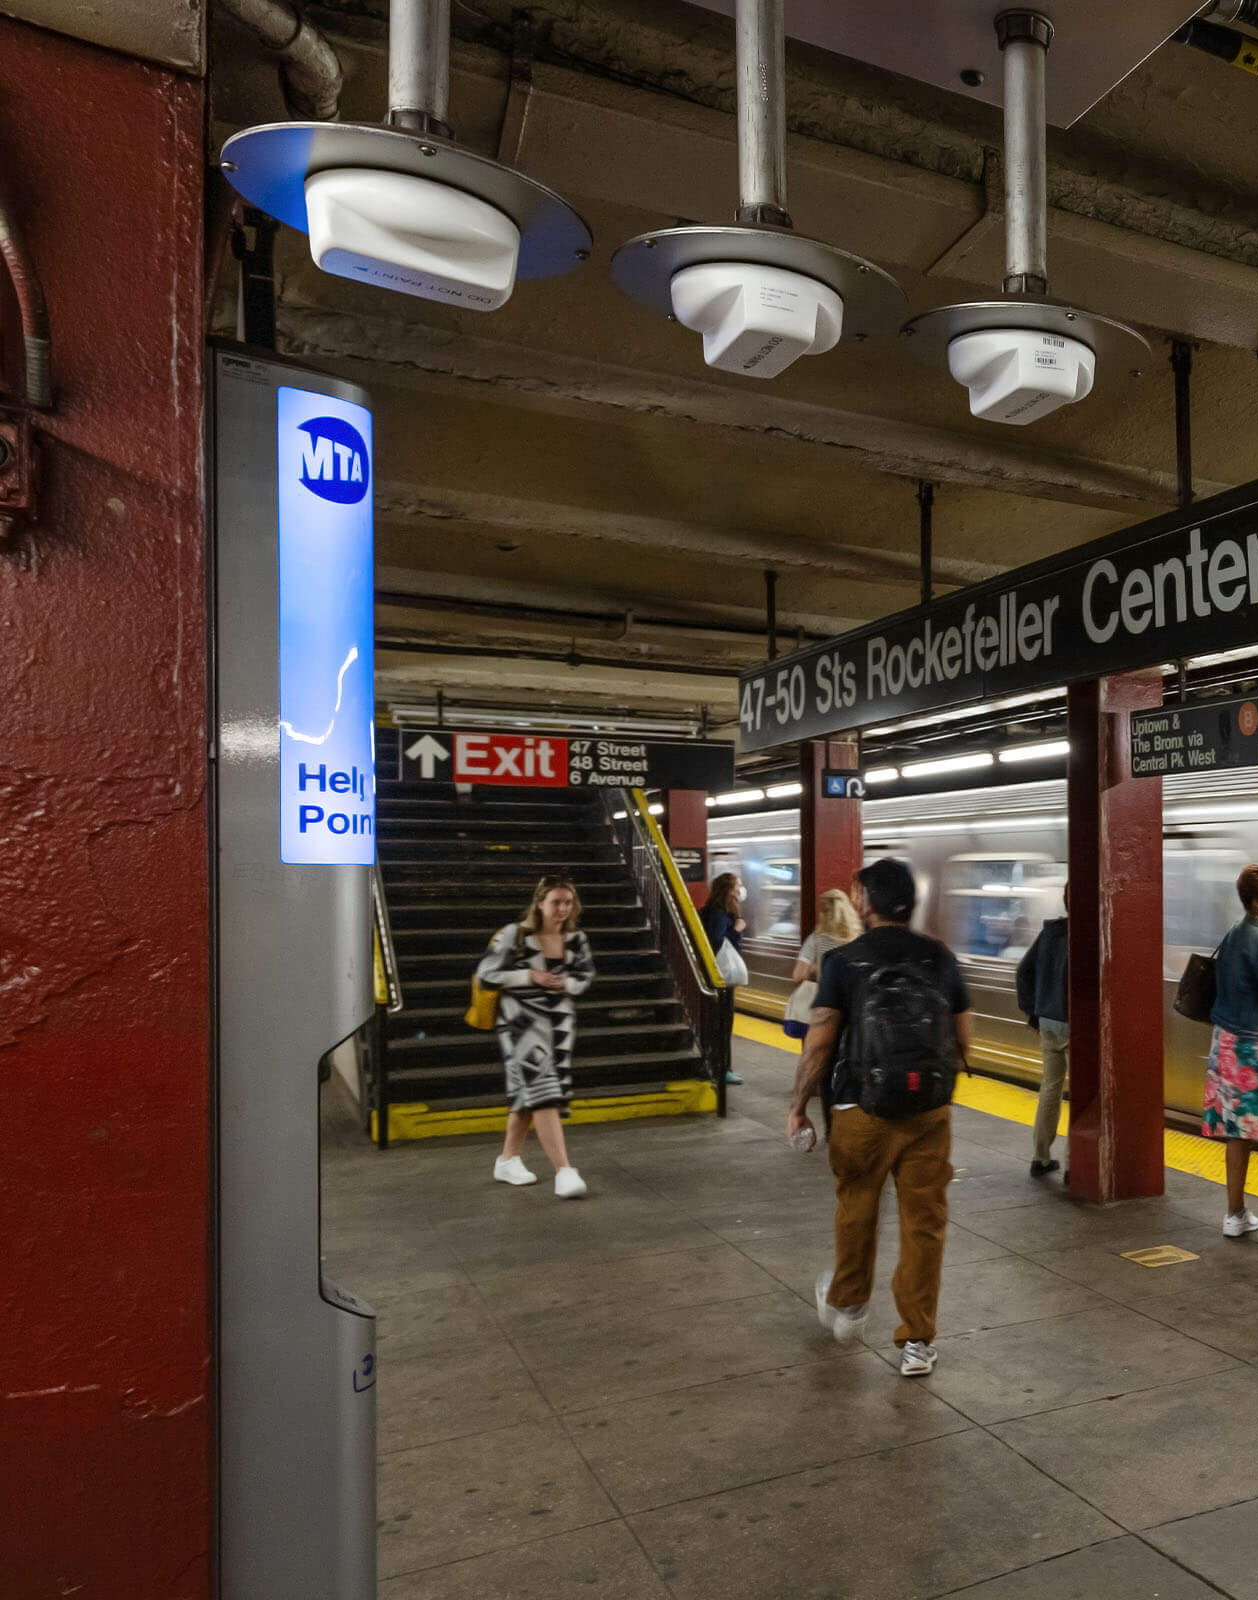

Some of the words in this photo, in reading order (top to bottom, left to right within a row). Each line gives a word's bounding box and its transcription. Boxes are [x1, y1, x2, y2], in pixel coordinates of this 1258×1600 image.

[373, 270, 422, 287] PAINT
[430, 284, 463, 298] NOT
[467, 294, 492, 305] DO
[298, 431, 363, 482] MTA
[739, 664, 806, 733] 47-50
[815, 651, 857, 715] Sts
[866, 591, 1060, 701] Rockefeller
[1131, 717, 1169, 738] Uptown
[1171, 713, 1180, 730] &
[569, 740, 592, 755] 47
[597, 741, 647, 757] Street
[1132, 738, 1151, 754] The
[1153, 735, 1185, 751] Bronx
[1188, 730, 1204, 747] via
[455, 734, 555, 778] Exit
[569, 755, 593, 770] 48
[599, 756, 649, 772] Street
[1132, 753, 1168, 773] Central
[1170, 752, 1185, 769] Pk
[1188, 747, 1217, 767] West
[569, 770, 582, 785] 6
[587, 771, 646, 787] Avenue
